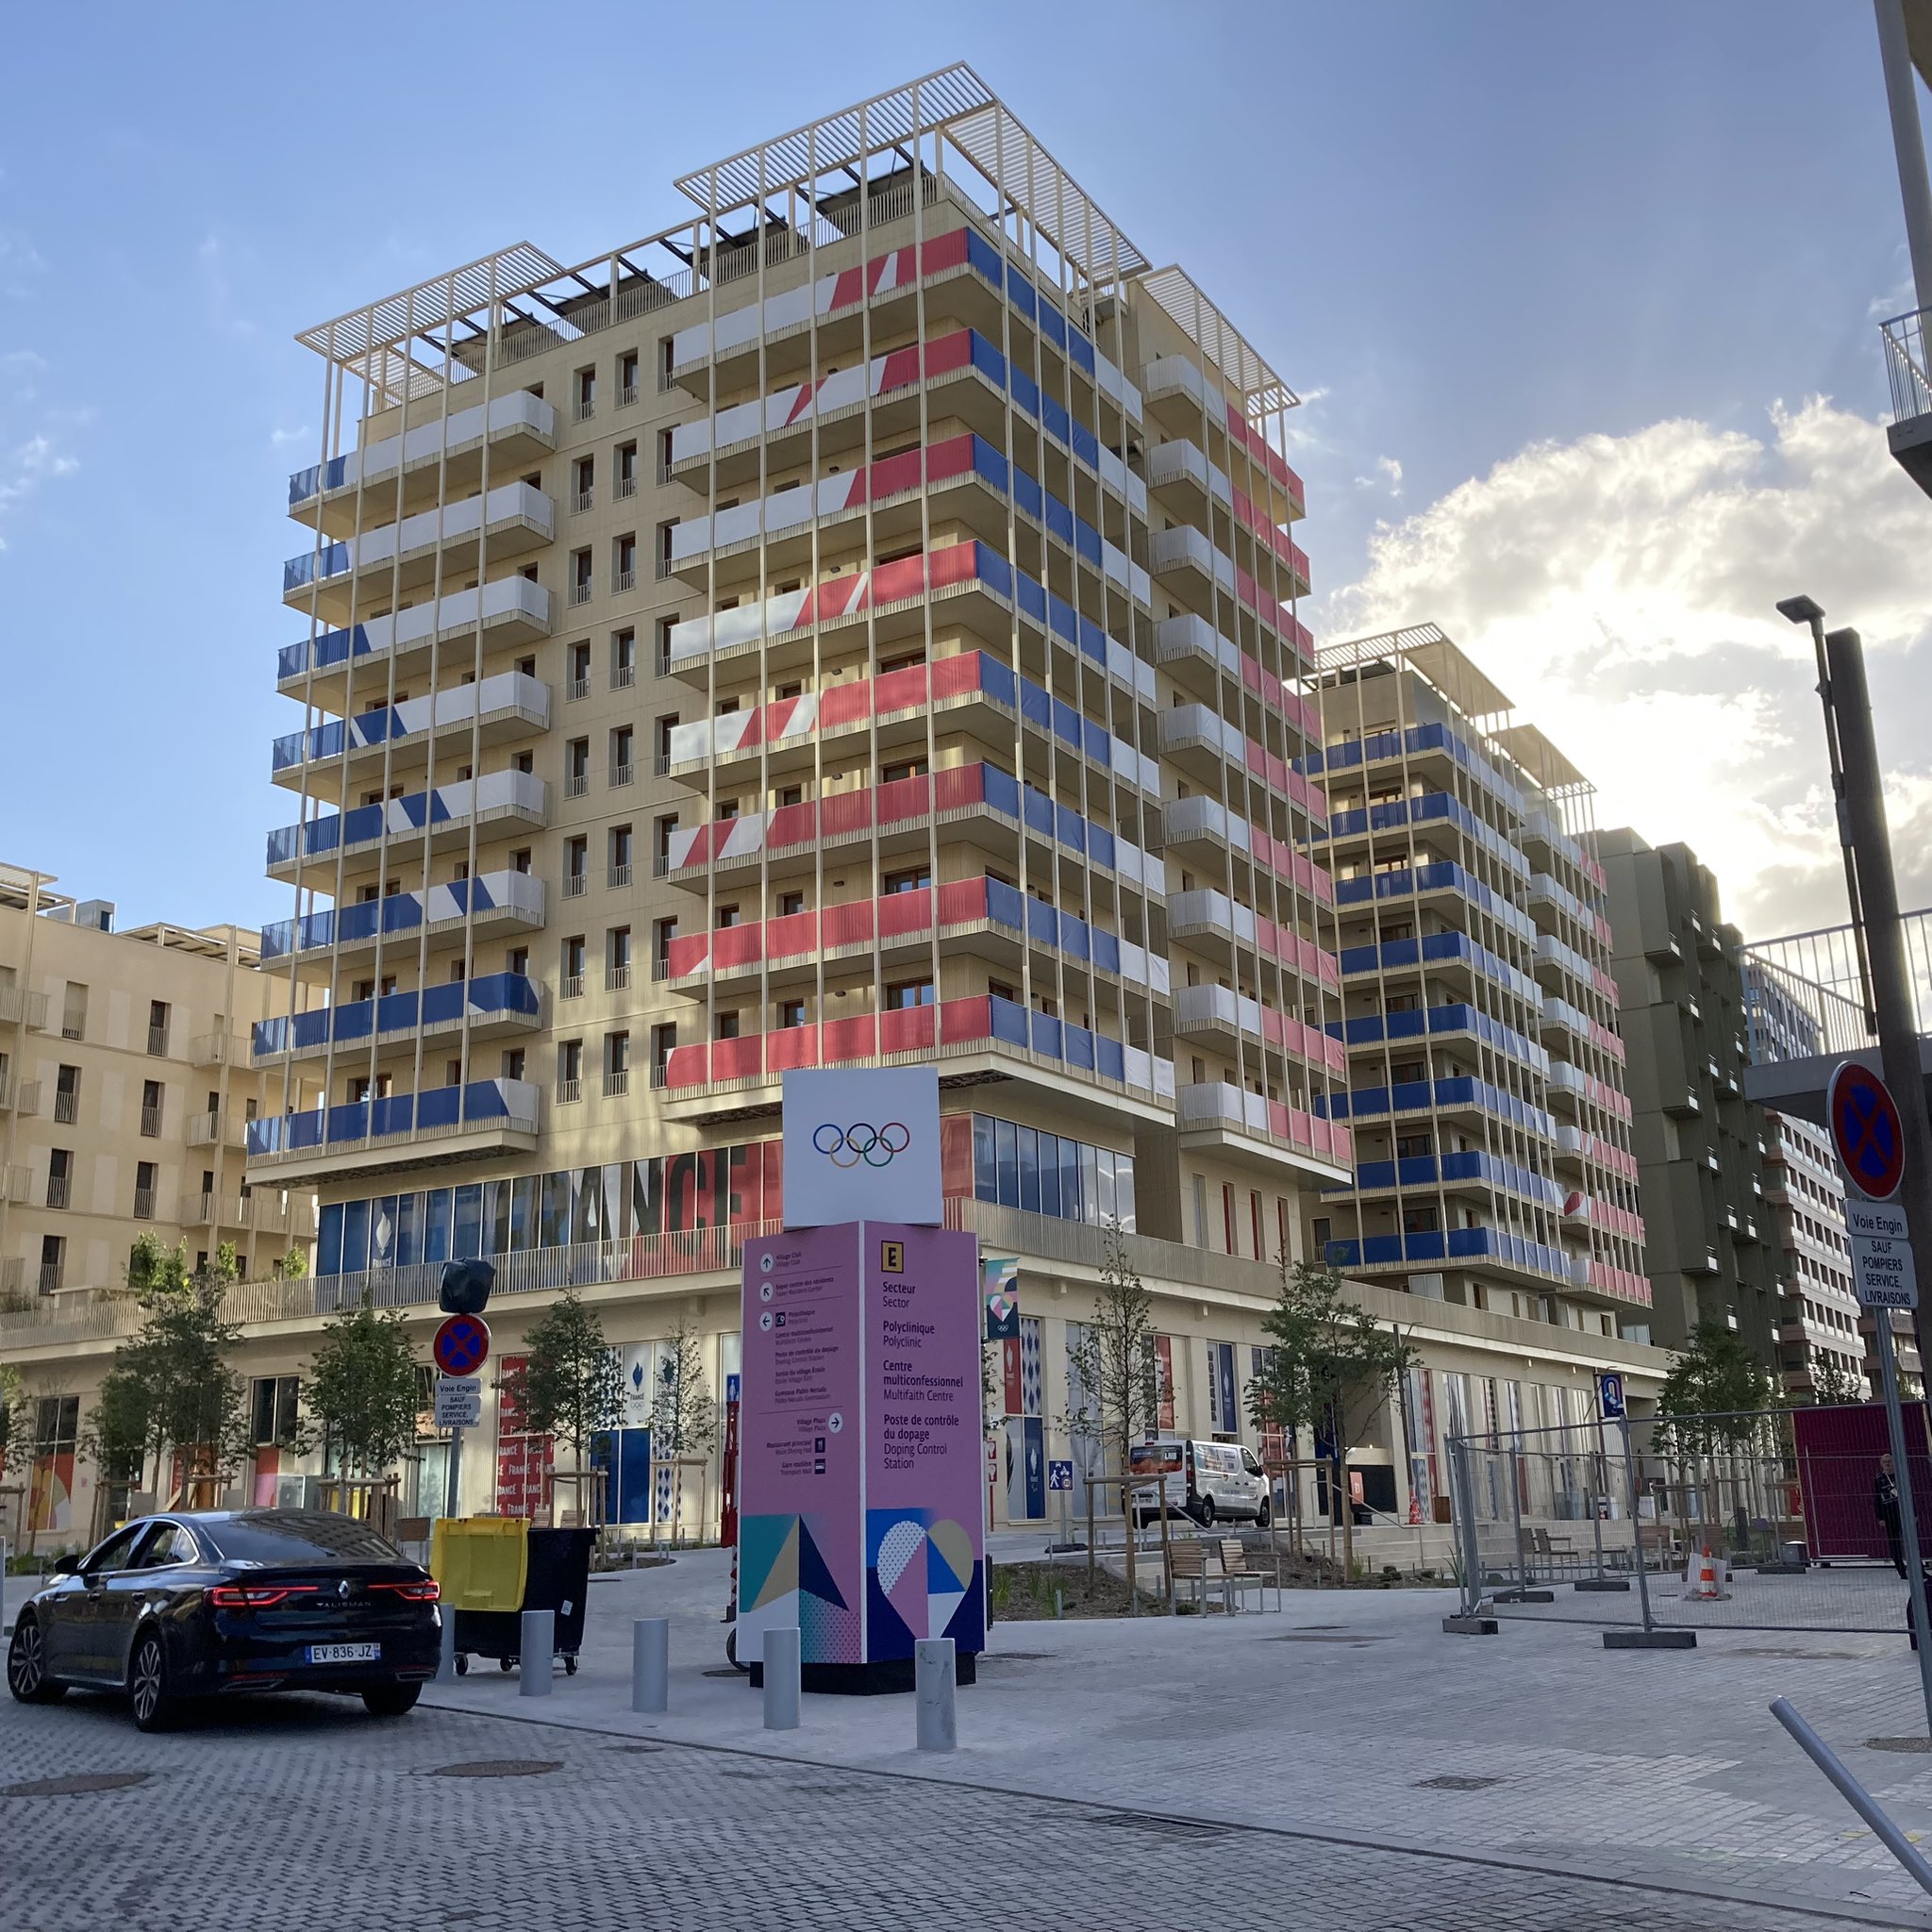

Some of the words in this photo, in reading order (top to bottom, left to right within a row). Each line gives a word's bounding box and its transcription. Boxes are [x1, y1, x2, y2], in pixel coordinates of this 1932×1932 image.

[1853, 1213, 1874, 1229] Voie
[1876, 1216, 1903, 1235] Engin
[1872, 1241, 1892, 1255] SAUF
[888, 1246, 897, 1267] E
[1862, 1256, 1903, 1272] POMPIERS
[883, 1281, 916, 1294] Secteur
[1865, 1273, 1902, 1291] SERVICE,
[883, 1296, 910, 1308] Sector
[1864, 1290, 1911, 1306] LIVRAISONS
[883, 1321, 936, 1336] Polyclinique
[883, 1335, 923, 1349] Polyclinic
[883, 1359, 913, 1372] Centre
[883, 1374, 964, 1388] multiconfessionnel
[457, 1385, 476, 1393] Engin
[884, 1389, 924, 1401] Multifaith
[926, 1391, 955, 1402] Centre
[884, 1413, 908, 1425] Poste
[911, 1414, 923, 1425] de
[924, 1415, 959, 1426] contrôle
[884, 1427, 895, 1440] du
[898, 1428, 930, 1442] dopage
[500, 1443, 518, 1457] RANCE
[884, 1443, 915, 1457] Doping
[917, 1443, 947, 1455] Control
[884, 1457, 915, 1470] Station
[498, 1483, 517, 1496] RANCE
